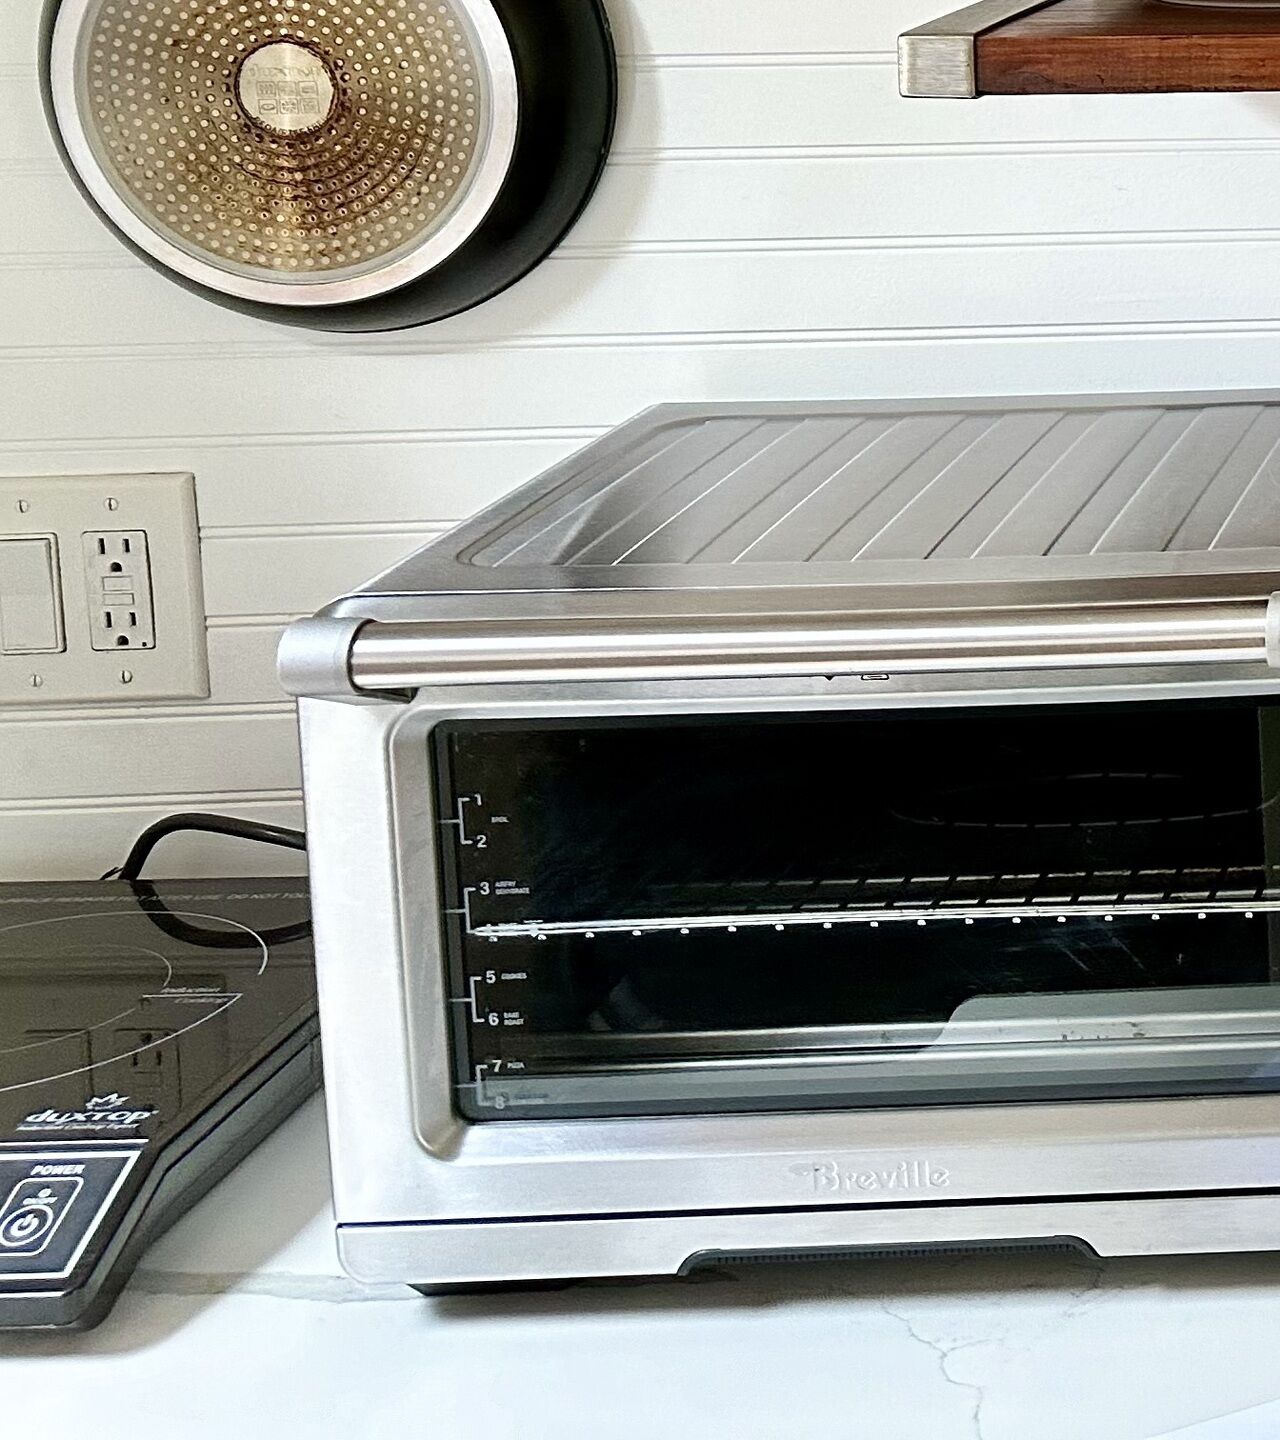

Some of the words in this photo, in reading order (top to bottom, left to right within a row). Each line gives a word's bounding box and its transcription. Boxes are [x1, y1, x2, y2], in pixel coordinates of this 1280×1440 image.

[476, 835, 488, 848] 2
[479, 882, 490, 895] 3
[486, 970, 496, 984] 5
[488, 1013, 500, 1026] 6
[491, 1059, 502, 1072] 7
[30, 1164, 86, 1176] POWER
[805, 1160, 950, 1191] Breville
